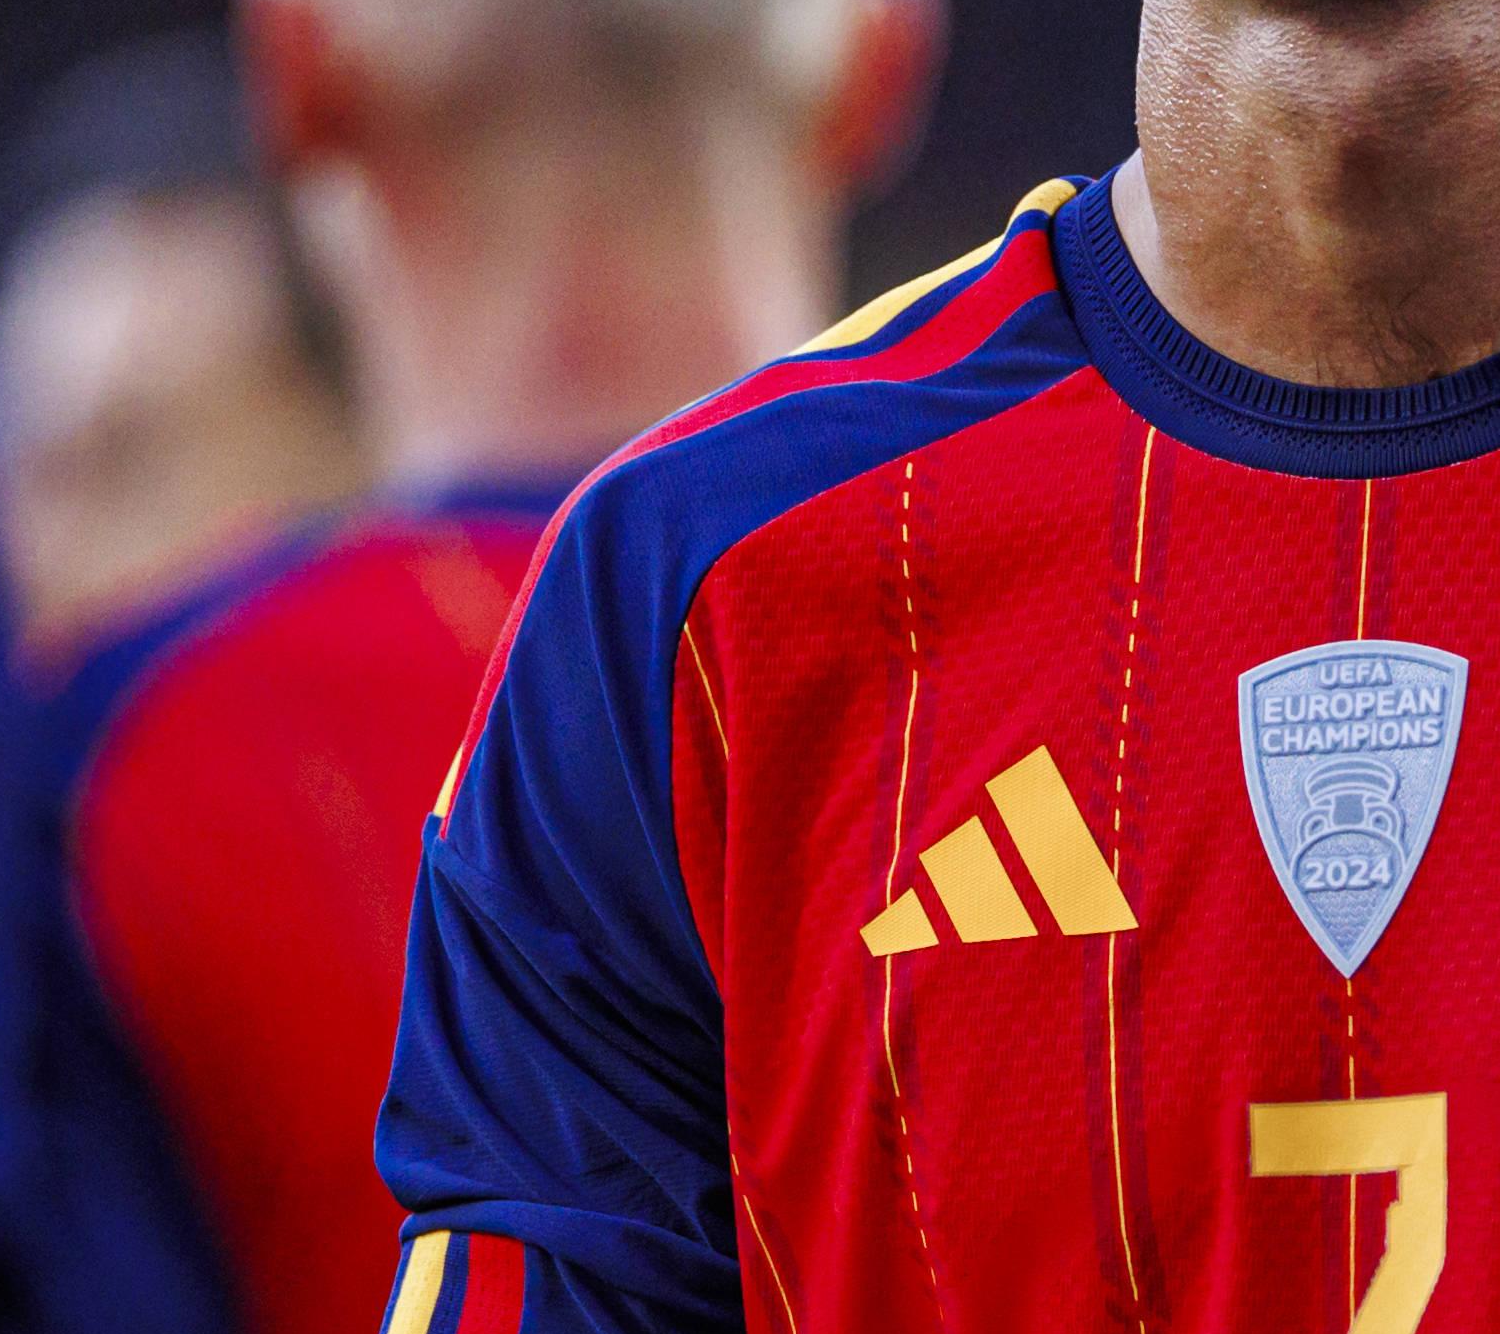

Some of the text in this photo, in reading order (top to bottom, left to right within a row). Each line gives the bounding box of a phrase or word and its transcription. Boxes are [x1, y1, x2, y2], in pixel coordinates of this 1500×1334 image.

[1319, 662, 1389, 685] UEFA
[1263, 686, 1442, 723] EUROPEAN
[1262, 718, 1441, 753] CHAMPIONS
[1303, 857, 1391, 888] 2024
